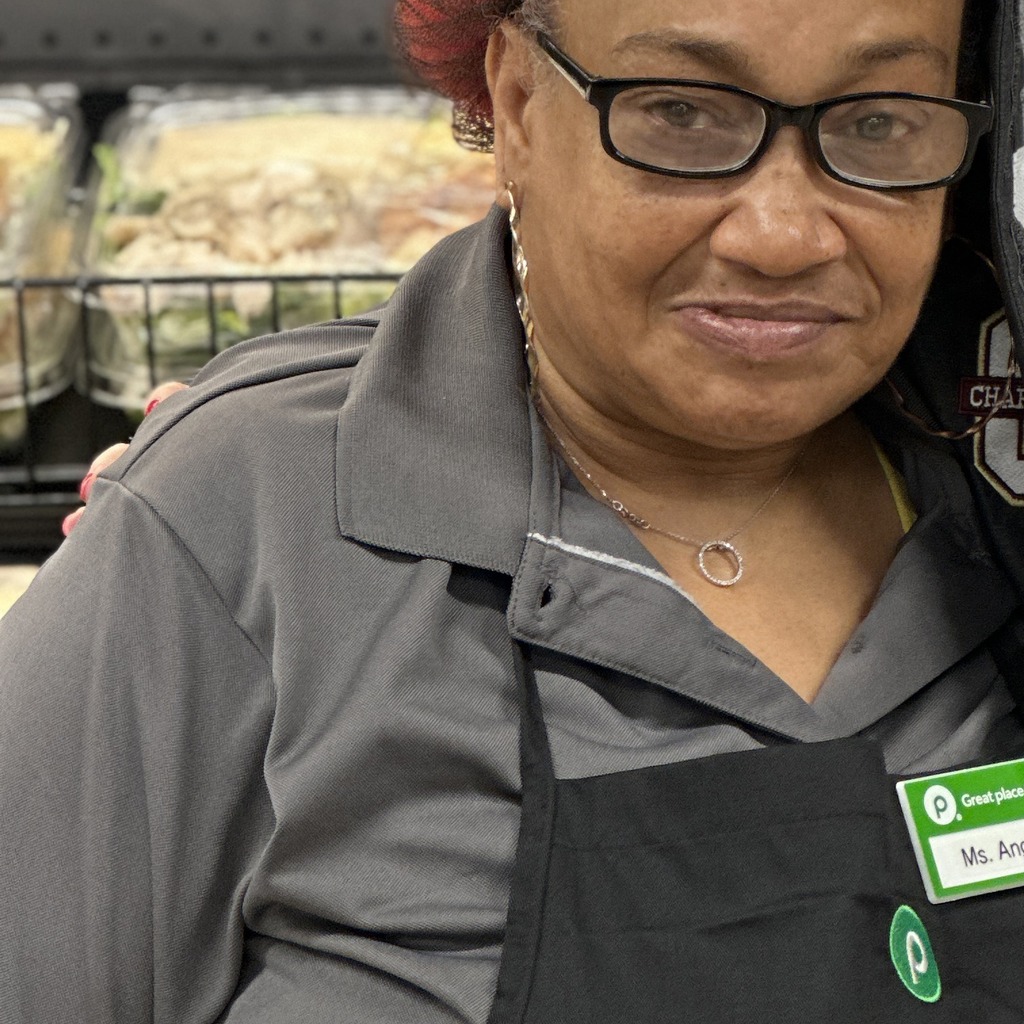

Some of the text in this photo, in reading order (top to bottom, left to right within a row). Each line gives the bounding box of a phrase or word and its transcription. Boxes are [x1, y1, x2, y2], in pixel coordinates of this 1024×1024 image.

[961, 792, 994, 807] Great
[995, 787, 1024, 805] place
[961, 847, 994, 867] Ms.
